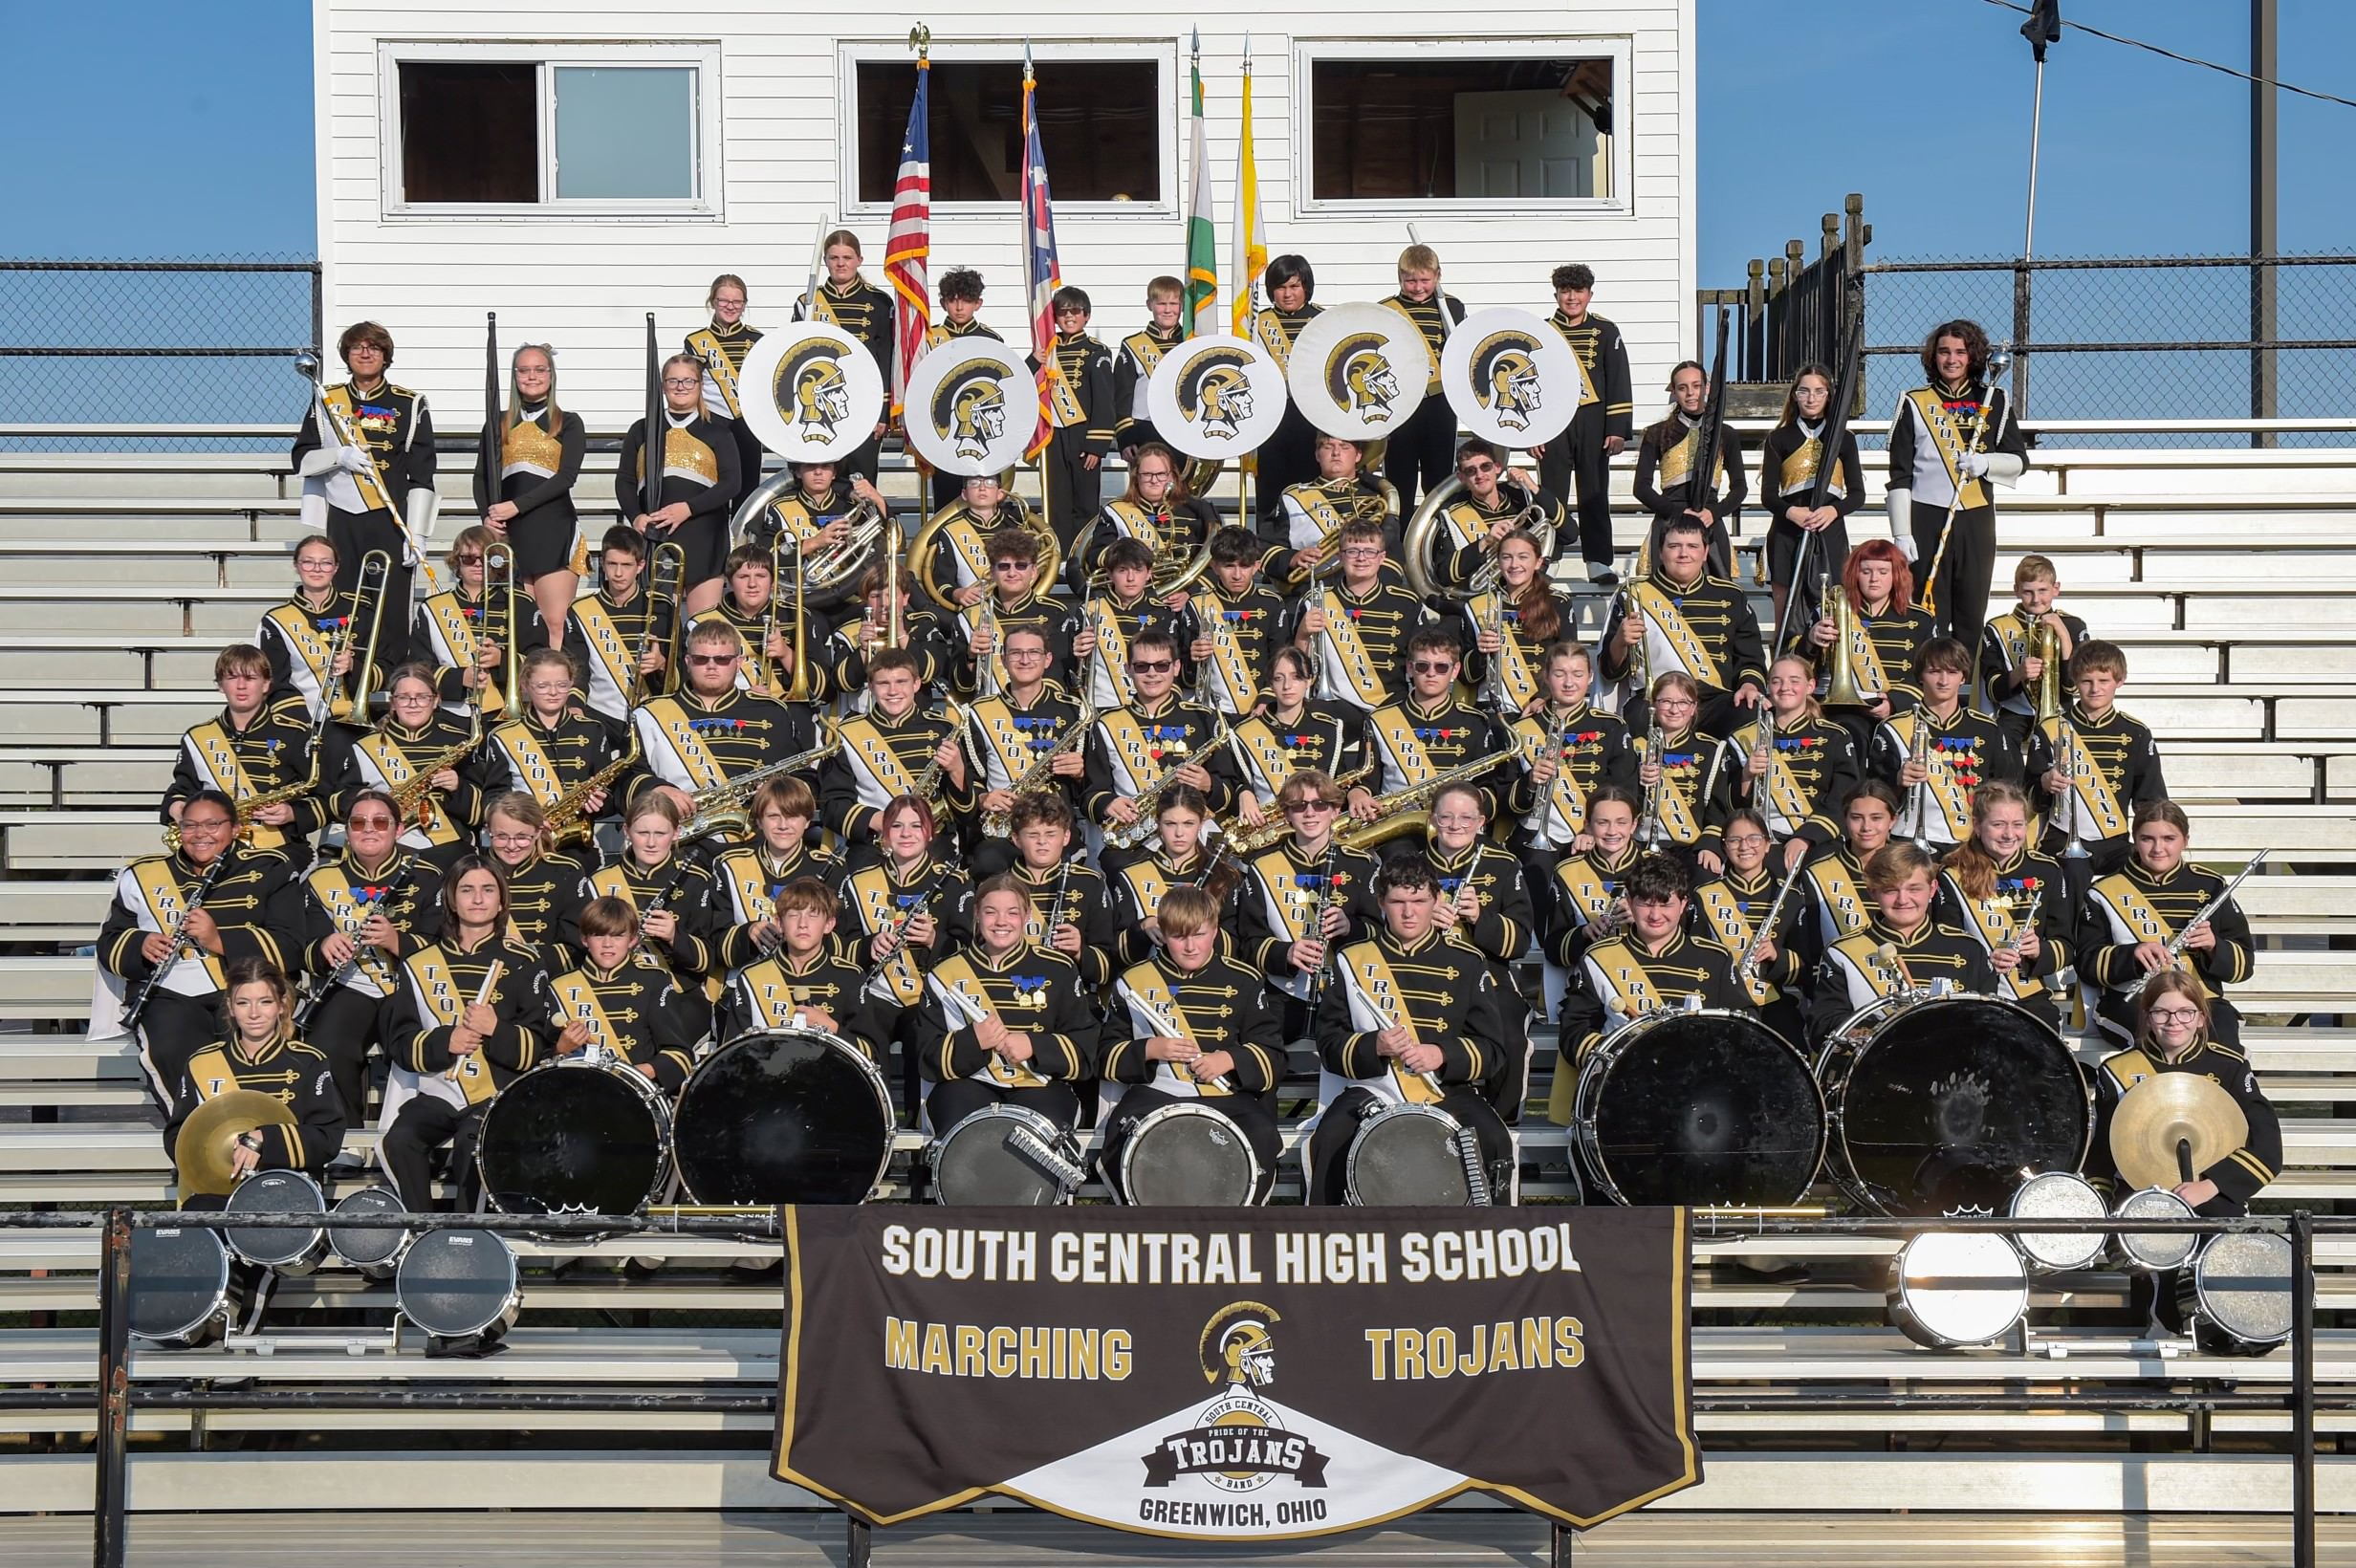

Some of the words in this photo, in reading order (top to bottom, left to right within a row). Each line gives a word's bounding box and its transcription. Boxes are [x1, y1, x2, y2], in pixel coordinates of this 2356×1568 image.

[1325, 607, 1375, 690] TROJANS
[1649, 599, 1709, 677] TROJANS
[1851, 630, 1884, 689] ROJAN
[515, 740, 560, 802] TROJA
[671, 722, 721, 788] TROJAN
[993, 718, 1027, 771] TROJ
[1391, 730, 1428, 780] TROJ
[883, 1225, 1036, 1281] SOUTH
[1051, 1231, 1262, 1284] CENTRAL
[1276, 1232, 1386, 1284] HIGH
[1401, 1223, 1582, 1282] SCHOOL
[884, 1316, 1132, 1381] MARCHING
[1364, 1317, 1584, 1380] TROJANS
[1205, 1404, 1232, 1424] SOUTH
[1235, 1400, 1273, 1424] CENTRAL
[1209, 1428, 1233, 1437] PRIDE
[1253, 1428, 1270, 1437] THE
[1167, 1437, 1306, 1470] TROJANS
[1139, 1498, 1271, 1528] GREENWICH,
[1276, 1498, 1327, 1524] OHIO
[1226, 1479, 1254, 1489] BAND
